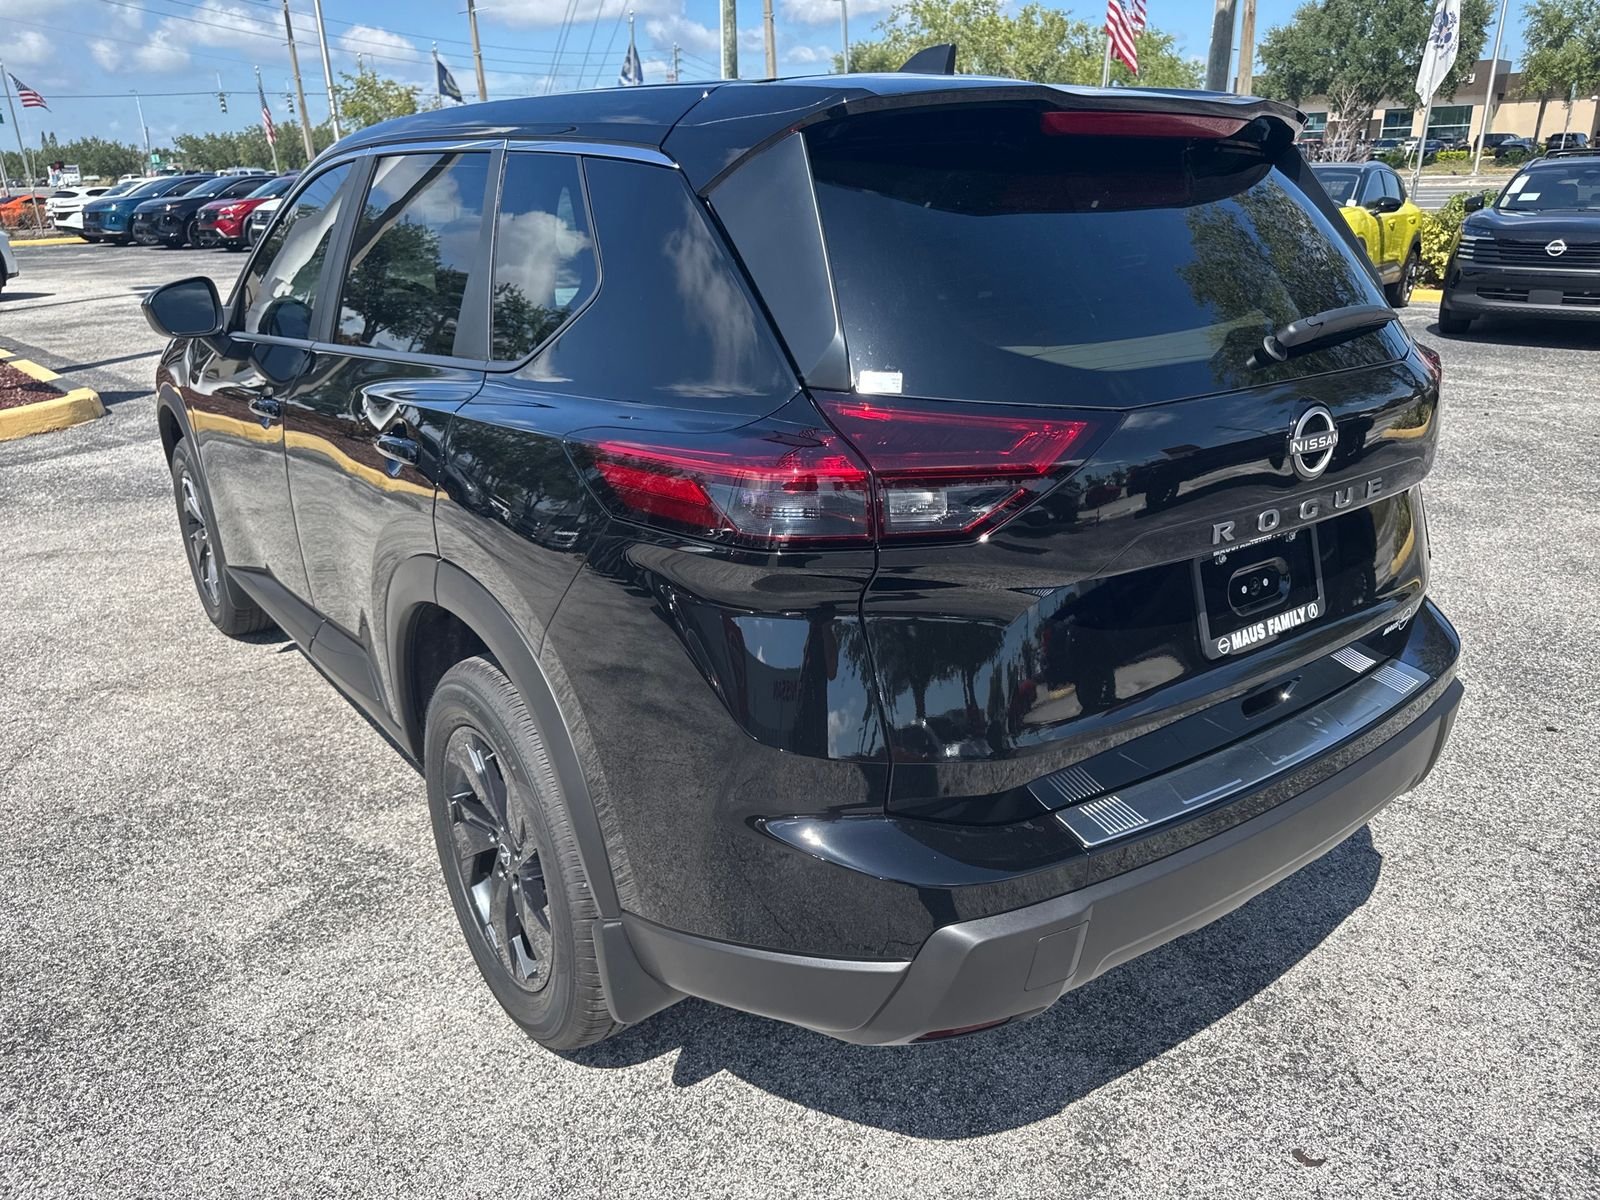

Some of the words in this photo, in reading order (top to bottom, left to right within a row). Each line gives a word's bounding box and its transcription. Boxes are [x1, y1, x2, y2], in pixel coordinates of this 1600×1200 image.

[1292, 431, 1338, 453] NISSAN
[1212, 477, 1383, 545] ROGUE
[1231, 623, 1266, 650] MAUS
[1266, 606, 1306, 636] FAMILY
